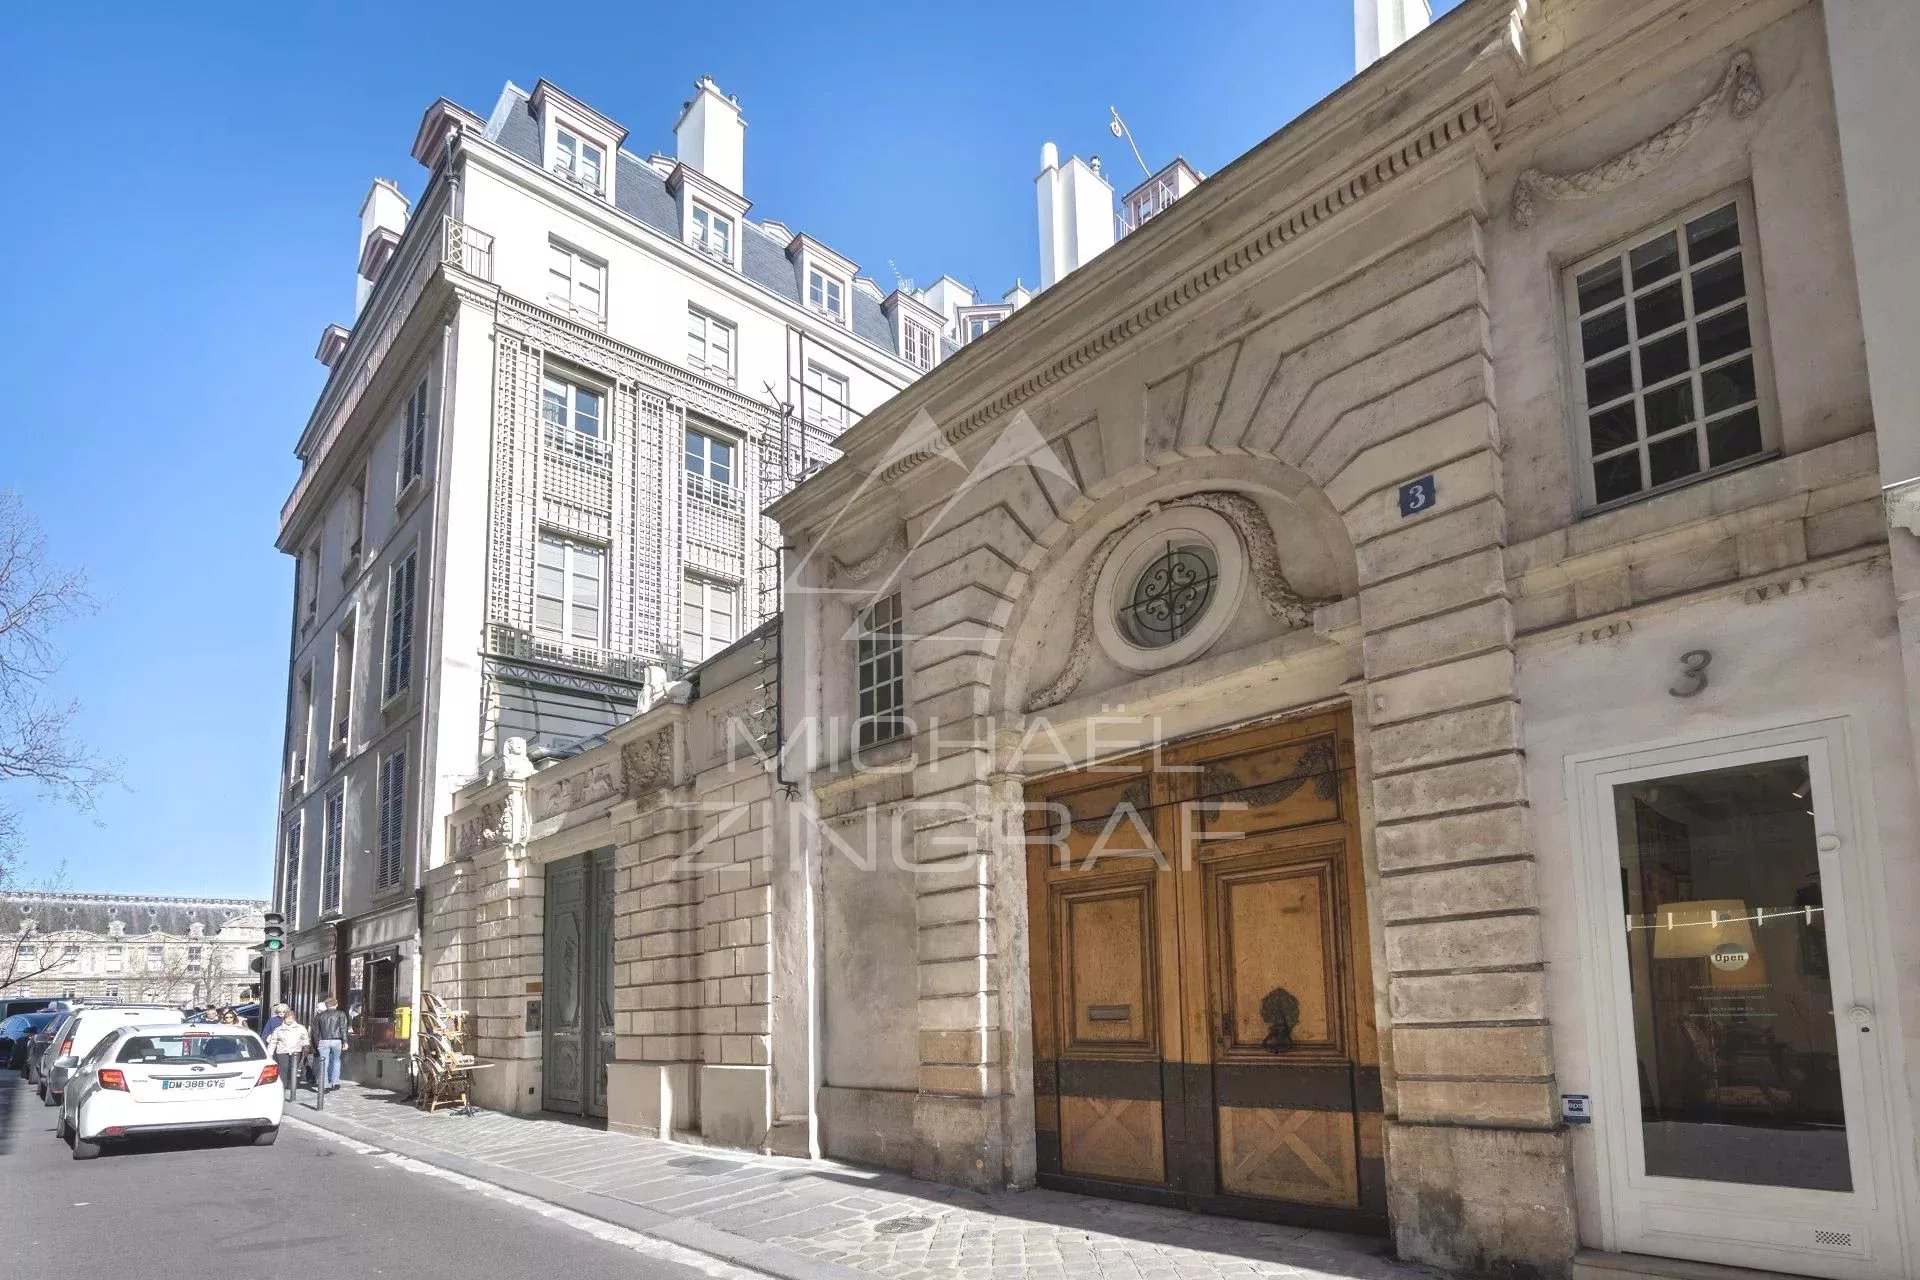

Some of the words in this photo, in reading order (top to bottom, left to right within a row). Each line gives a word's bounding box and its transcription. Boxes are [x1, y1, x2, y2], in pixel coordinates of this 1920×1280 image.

[1409, 484, 1426, 509] 3
[1668, 649, 1713, 699] 3
[1714, 953, 1745, 964] Open
